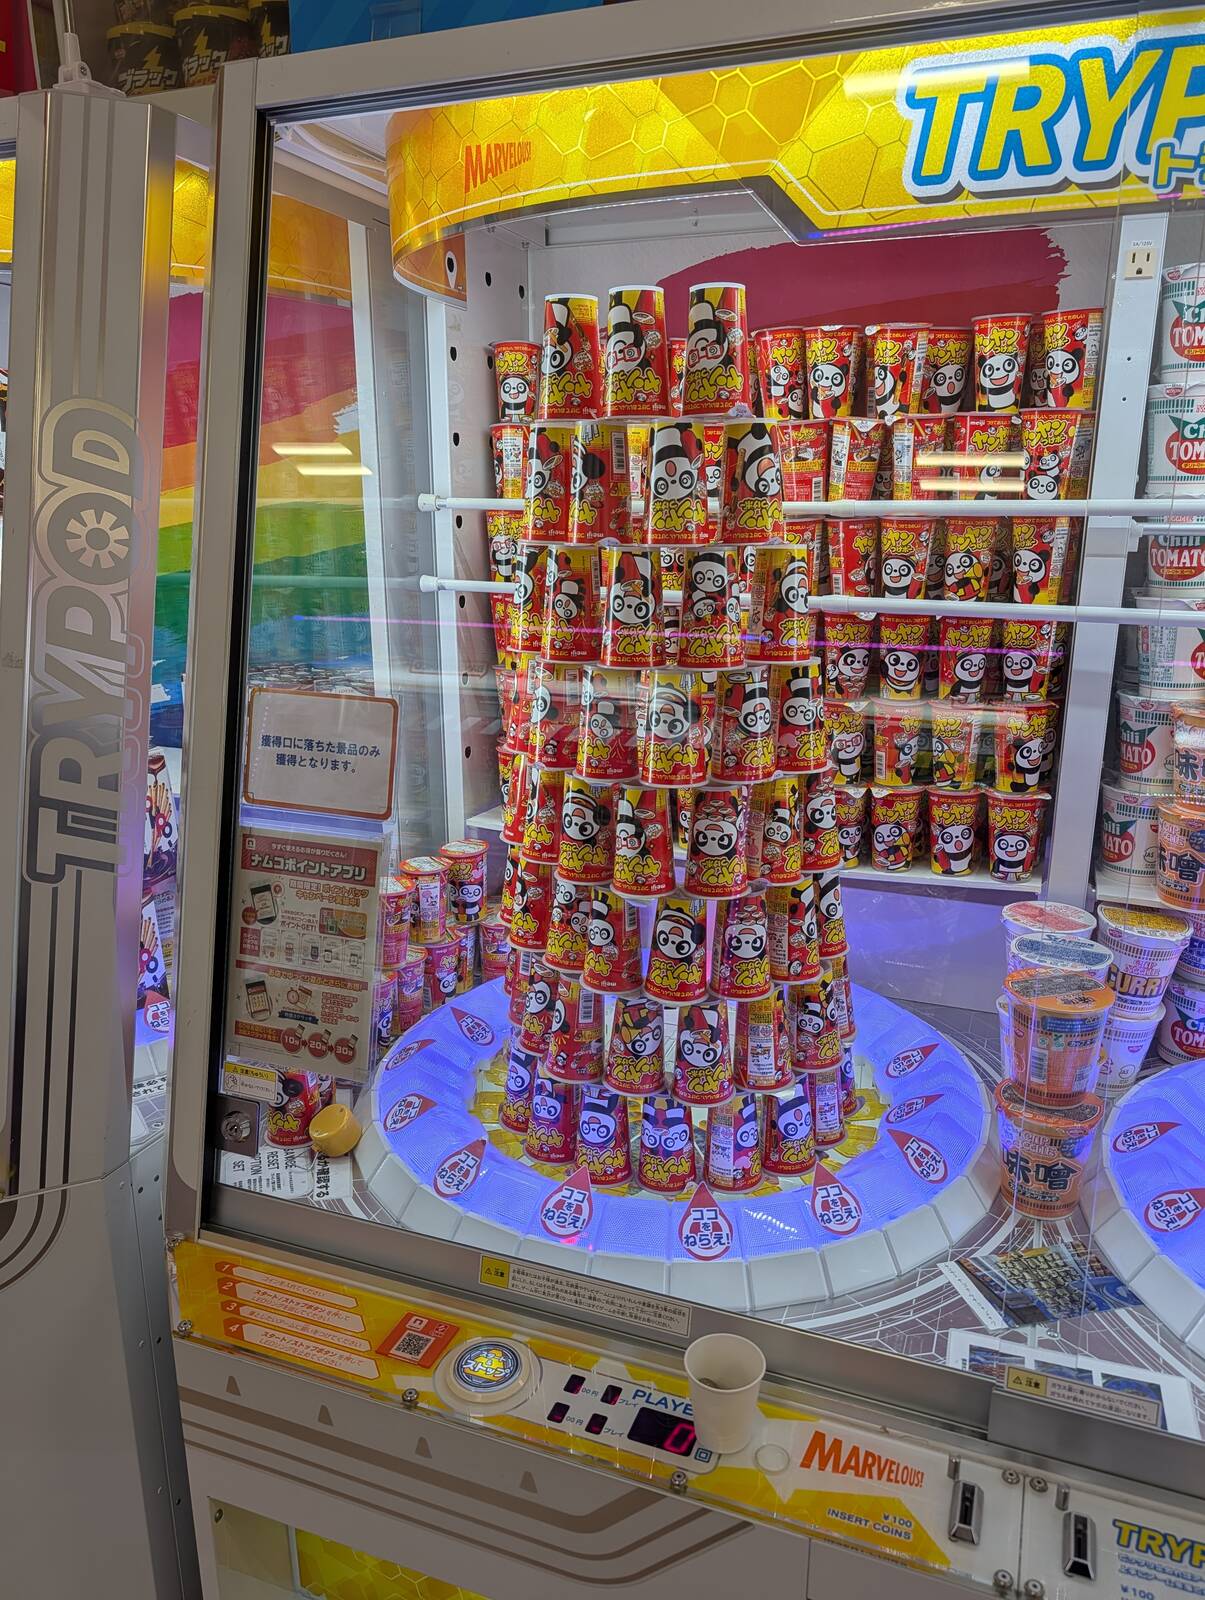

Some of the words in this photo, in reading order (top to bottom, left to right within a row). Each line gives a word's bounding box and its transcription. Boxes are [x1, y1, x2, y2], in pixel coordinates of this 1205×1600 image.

[464, 141, 531, 193] MARVELOUS!
[548, 528, 565, 536] meiji
[33, 402, 135, 878] TRYPOD
[261, 734, 381, 758] 獲得口に落ちた景品のみ
[276, 753, 356, 773] 獲得となります。
[251, 854, 367, 881] ナムコポイントアプリ
[650, 883, 667, 891] meiji
[904, 1138, 921, 1158] ココ
[266, 1151, 280, 1171] RESET
[458, 1152, 479, 1168] ココ
[919, 1150, 943, 1179] ねらえ!
[438, 1167, 469, 1192] ねらえ!
[560, 1187, 587, 1203] ココ
[817, 1185, 843, 1200] ココ
[1178, 1191, 1200, 1214] ココ
[543, 1207, 586, 1230] ねらえ!
[691, 1208, 718, 1221] ココ
[819, 1207, 861, 1225] ねらえ!
[1151, 1199, 1181, 1232] ねらえ!
[684, 1232, 730, 1247] ねらえ!
[222, 1281, 234, 1290] 2
[226, 1302, 237, 1311] 3
[463, 1359, 511, 1377] ストップ
[663, 1423, 697, 1454] 0
[800, 1430, 925, 1488] MARVELOUS!
[827, 1508, 870, 1527] INSERT
[873, 1522, 912, 1540] COINS
